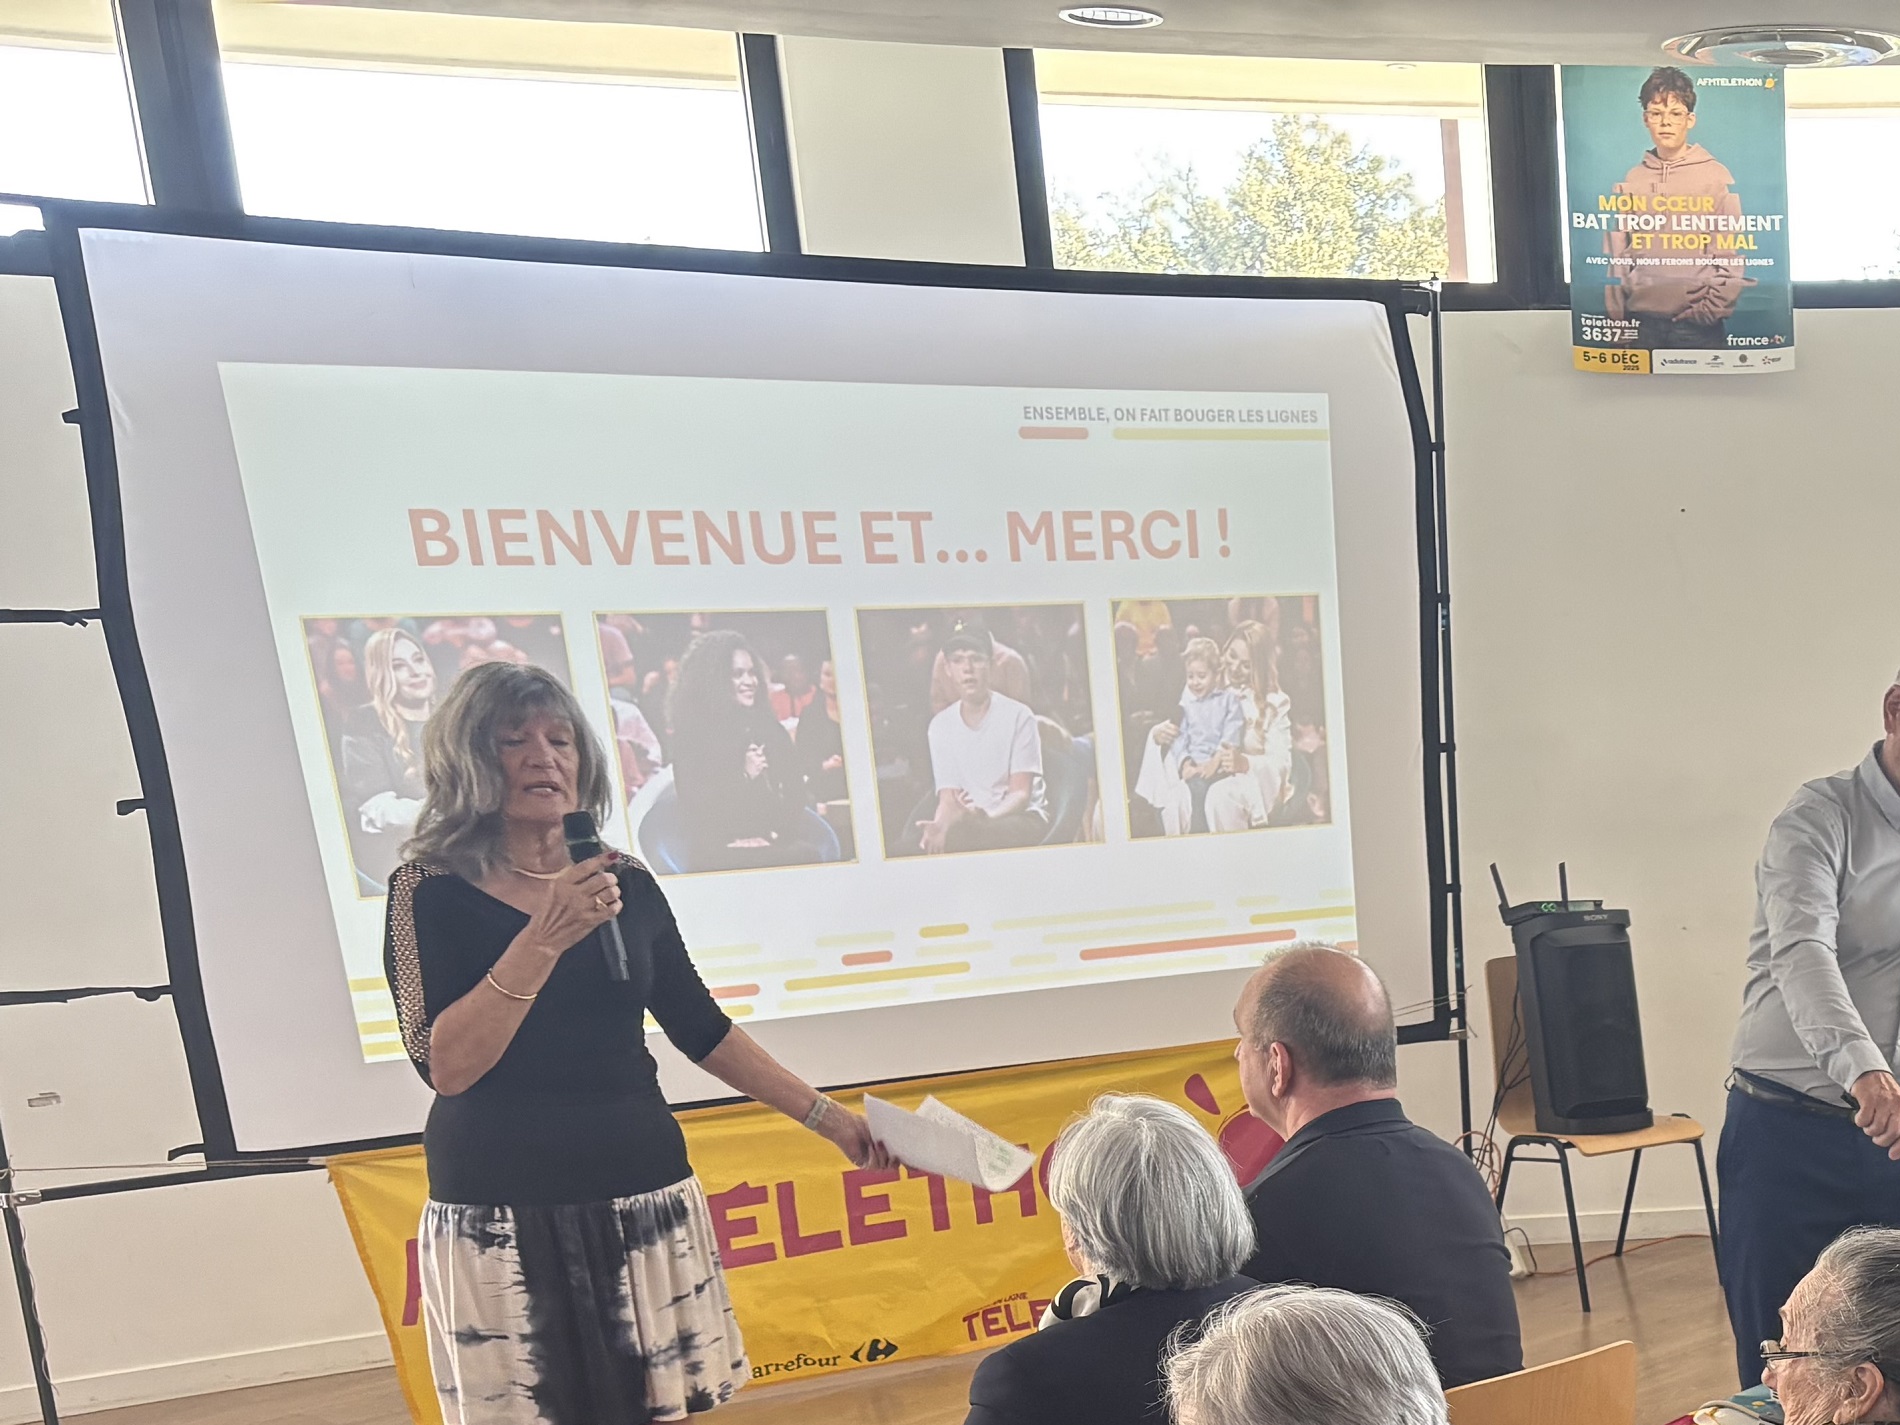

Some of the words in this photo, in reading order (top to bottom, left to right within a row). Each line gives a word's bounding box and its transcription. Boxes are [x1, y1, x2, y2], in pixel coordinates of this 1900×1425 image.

[1598, 195, 1647, 212] MON
[1652, 195, 1715, 212] CŒUR
[1572, 213, 1611, 230] BAT
[1614, 214, 1668, 231] TROP
[1671, 214, 1784, 231] LENTEMENT
[1631, 233, 1655, 250] ET
[1659, 234, 1712, 250] TROP
[1716, 234, 1758, 250] MAL
[1585, 256, 1609, 265] AVEC
[1636, 257, 1661, 266] NOUS
[1661, 257, 1694, 266] FERONS
[1695, 258, 1729, 266] BOUGER
[1729, 258, 1745, 266] LES
[1745, 258, 1775, 266] LIGNES
[1580, 317, 1641, 328] telethon.fr
[1581, 327, 1622, 342] 3637
[1583, 351, 1607, 364] 5-6
[1611, 350, 1640, 364] DÉC
[1023, 405, 1110, 423] ENSEMBLE,
[1114, 406, 1137, 421] ON
[1140, 408, 1171, 422] FAIT
[1174, 408, 1236, 423] BOUGER
[1238, 410, 1264, 423] LES
[1267, 410, 1319, 424] LIGNES
[407, 508, 843, 567] BIENVENUE
[859, 510, 988, 565] ET...
[1005, 508, 1200, 563] MERCI
[752, 1353, 842, 1379] arrefour
